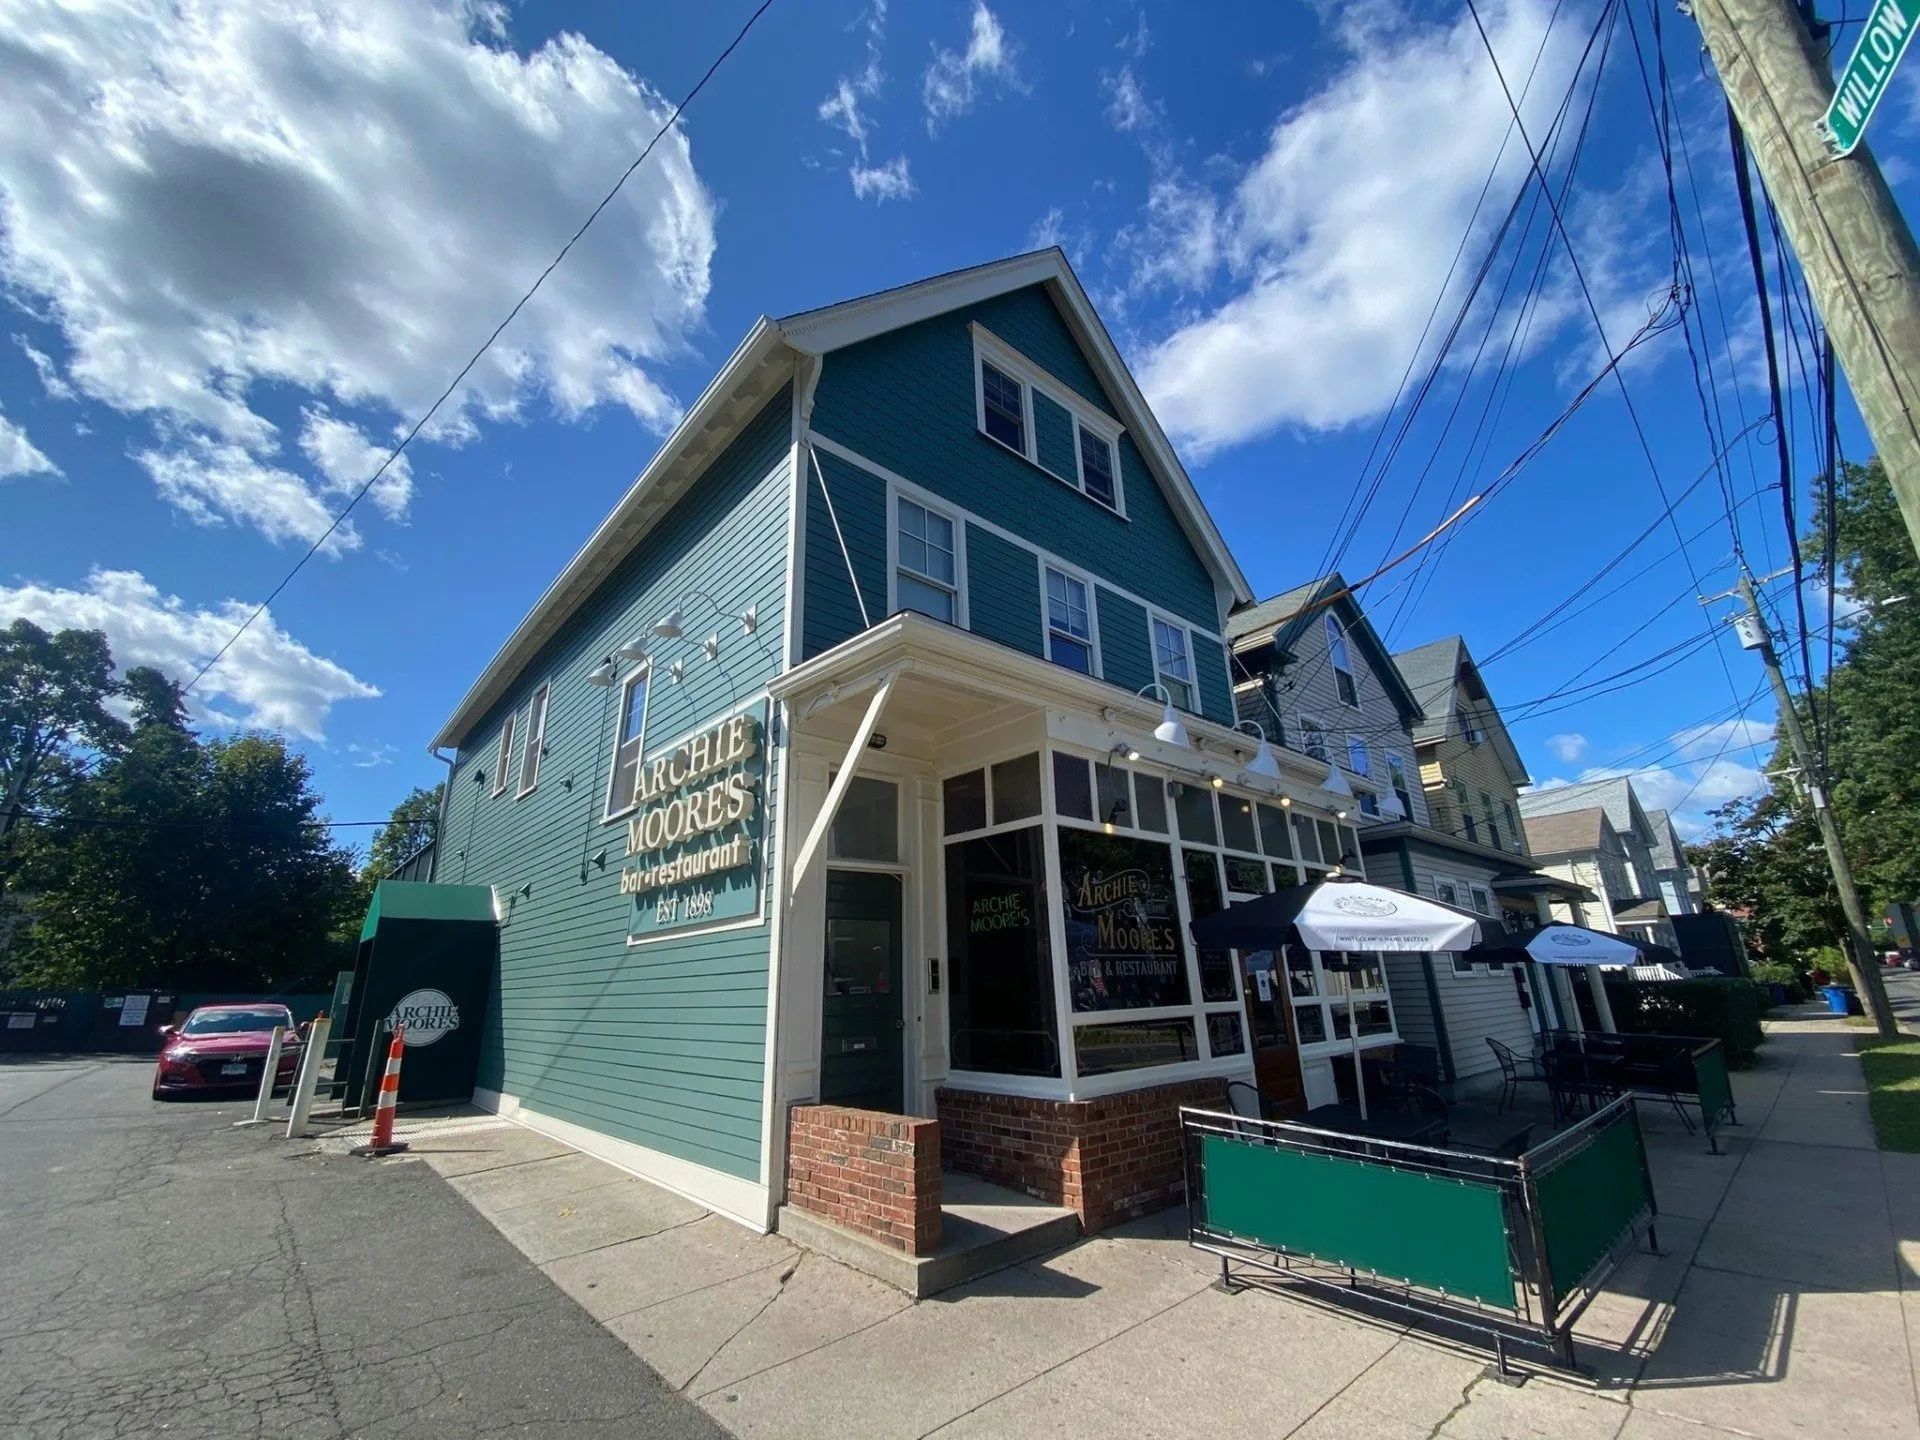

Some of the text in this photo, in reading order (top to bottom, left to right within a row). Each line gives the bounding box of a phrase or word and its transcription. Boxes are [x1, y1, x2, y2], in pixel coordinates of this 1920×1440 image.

[1837, 0, 1908, 128] WILLOW
[631, 714, 749, 804] ARCHIE
[972, 893, 1021, 914] ARCHIE
[1077, 870, 1137, 906] ARCHIE
[655, 890, 714, 923] EST 1898
[1115, 960, 1177, 975] RESTAURANT
[392, 1005, 458, 1018] ARCHIE
